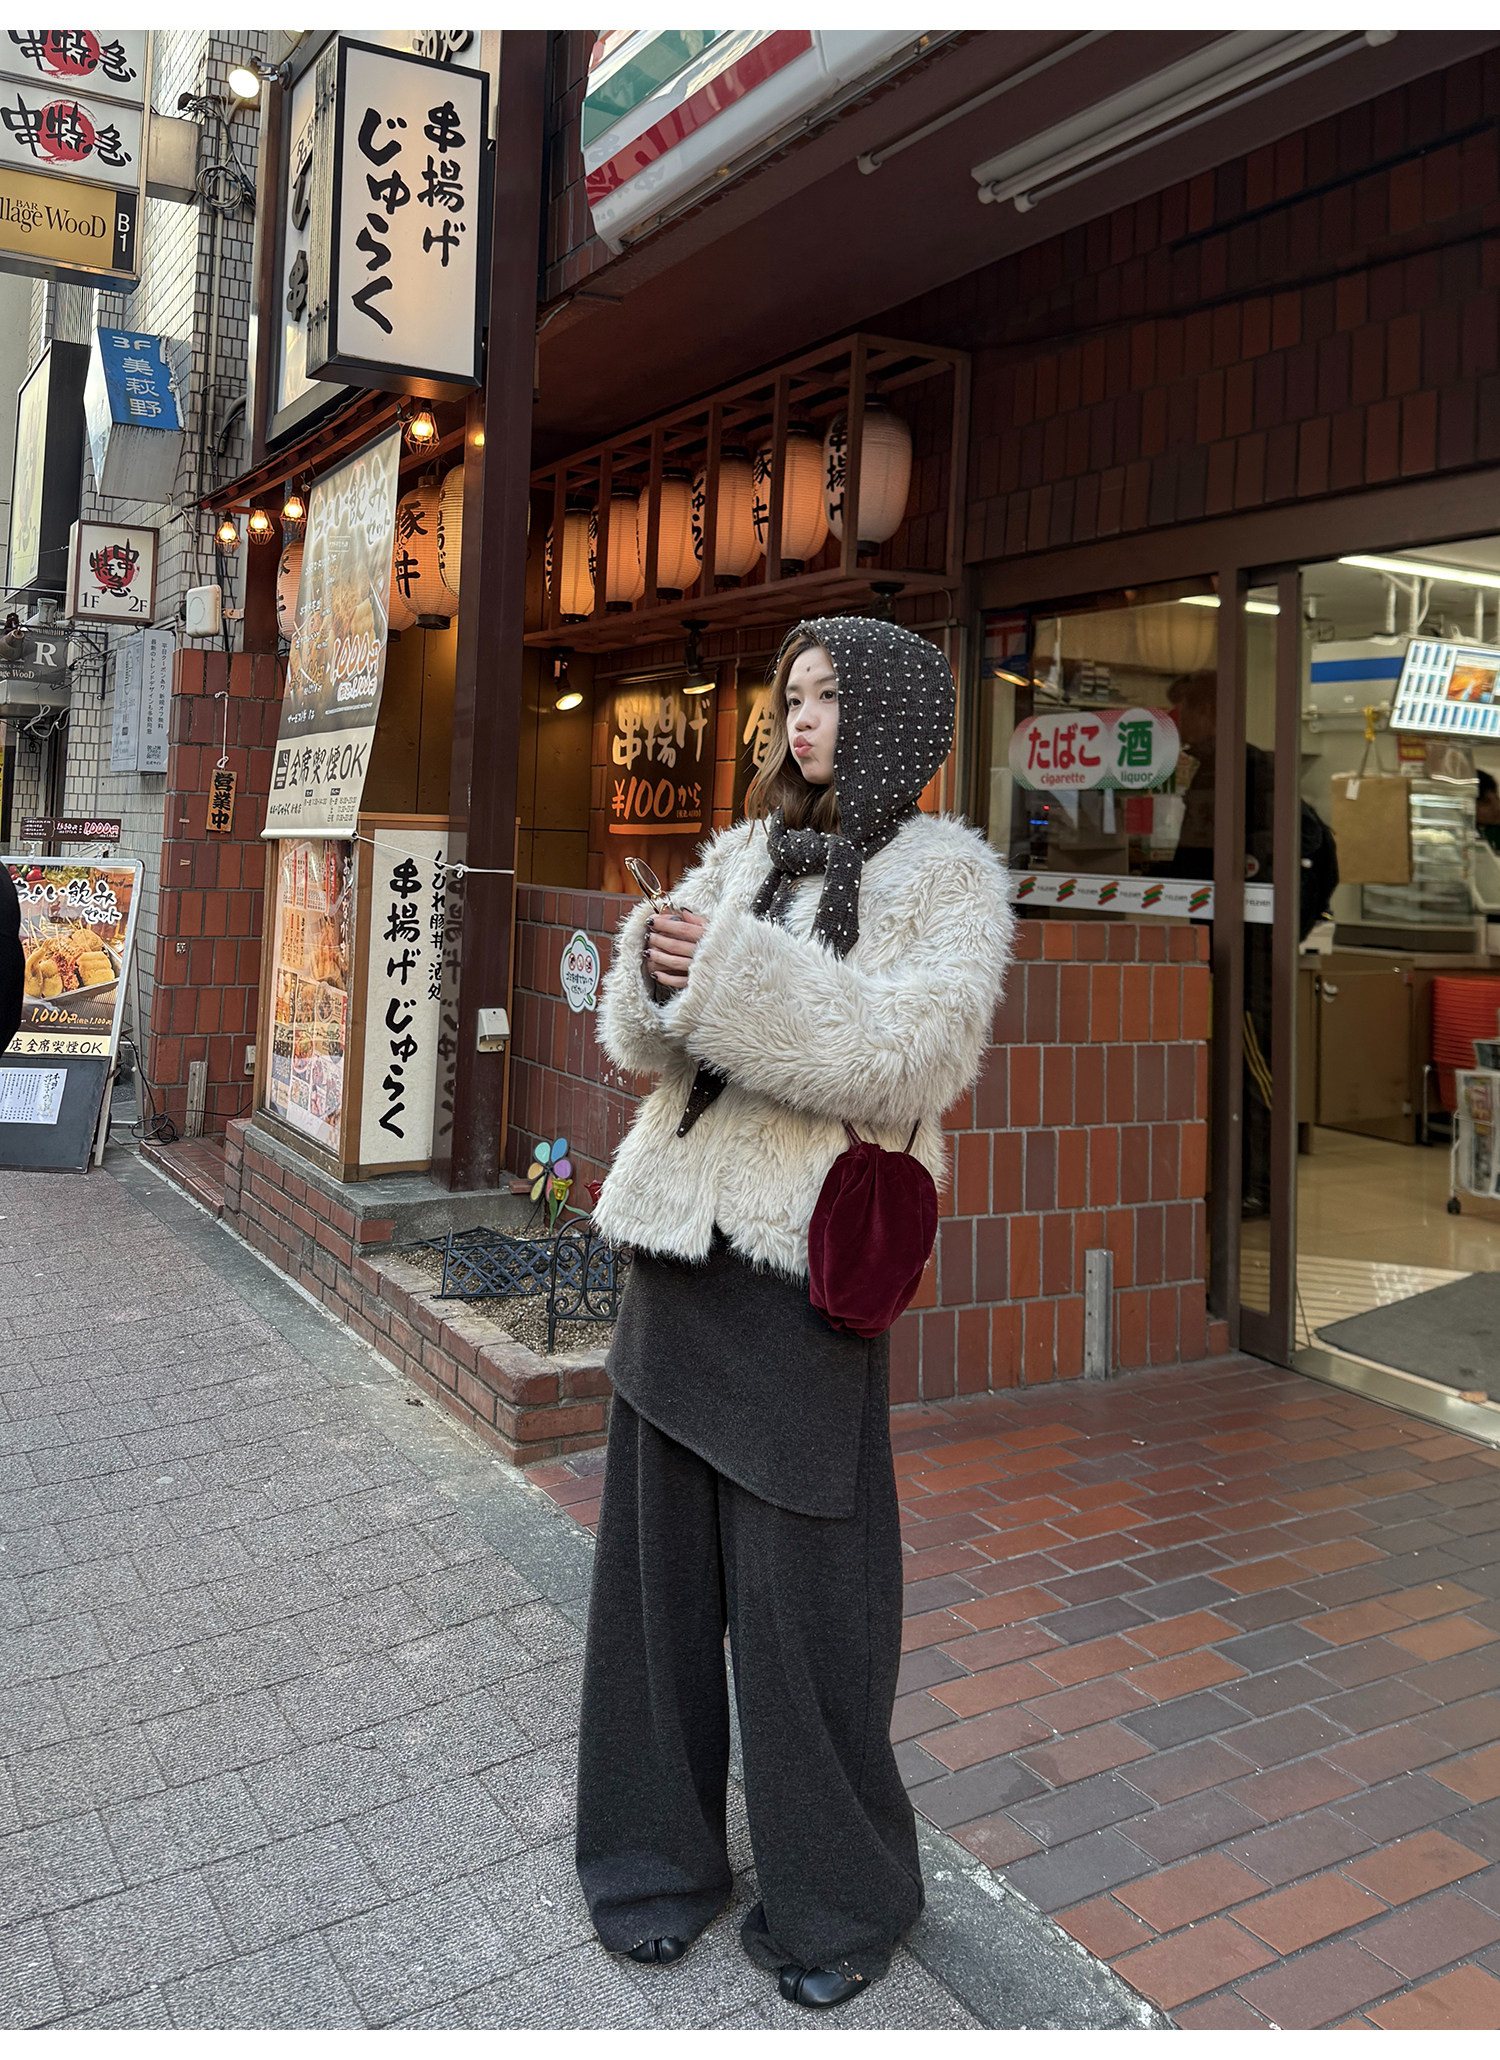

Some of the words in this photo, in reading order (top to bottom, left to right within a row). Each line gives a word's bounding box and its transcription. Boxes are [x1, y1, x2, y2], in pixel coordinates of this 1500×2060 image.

[16, 199, 38, 214] BAR
[417, 101, 466, 267] 串揚げ
[112, 336, 151, 350] 3F
[122, 356, 162, 418] 美萩野
[81, 592, 99, 608] 1F
[128, 596, 147, 612] 2F
[612, 695, 711, 770] 串揚げ
[1028, 723, 1100, 770] たばこ
[1117, 720, 1153, 767] 酒
[211, 772, 234, 830] 営業中
[1041, 772, 1086, 785] cigarette
[1120, 770, 1154, 784] liquor
[84, 905, 121, 924] セット
[384, 858, 422, 986] 串揚げ
[27, 1039, 103, 1054] 全席喫煙OK
[378, 998, 419, 1139] じゅらく
